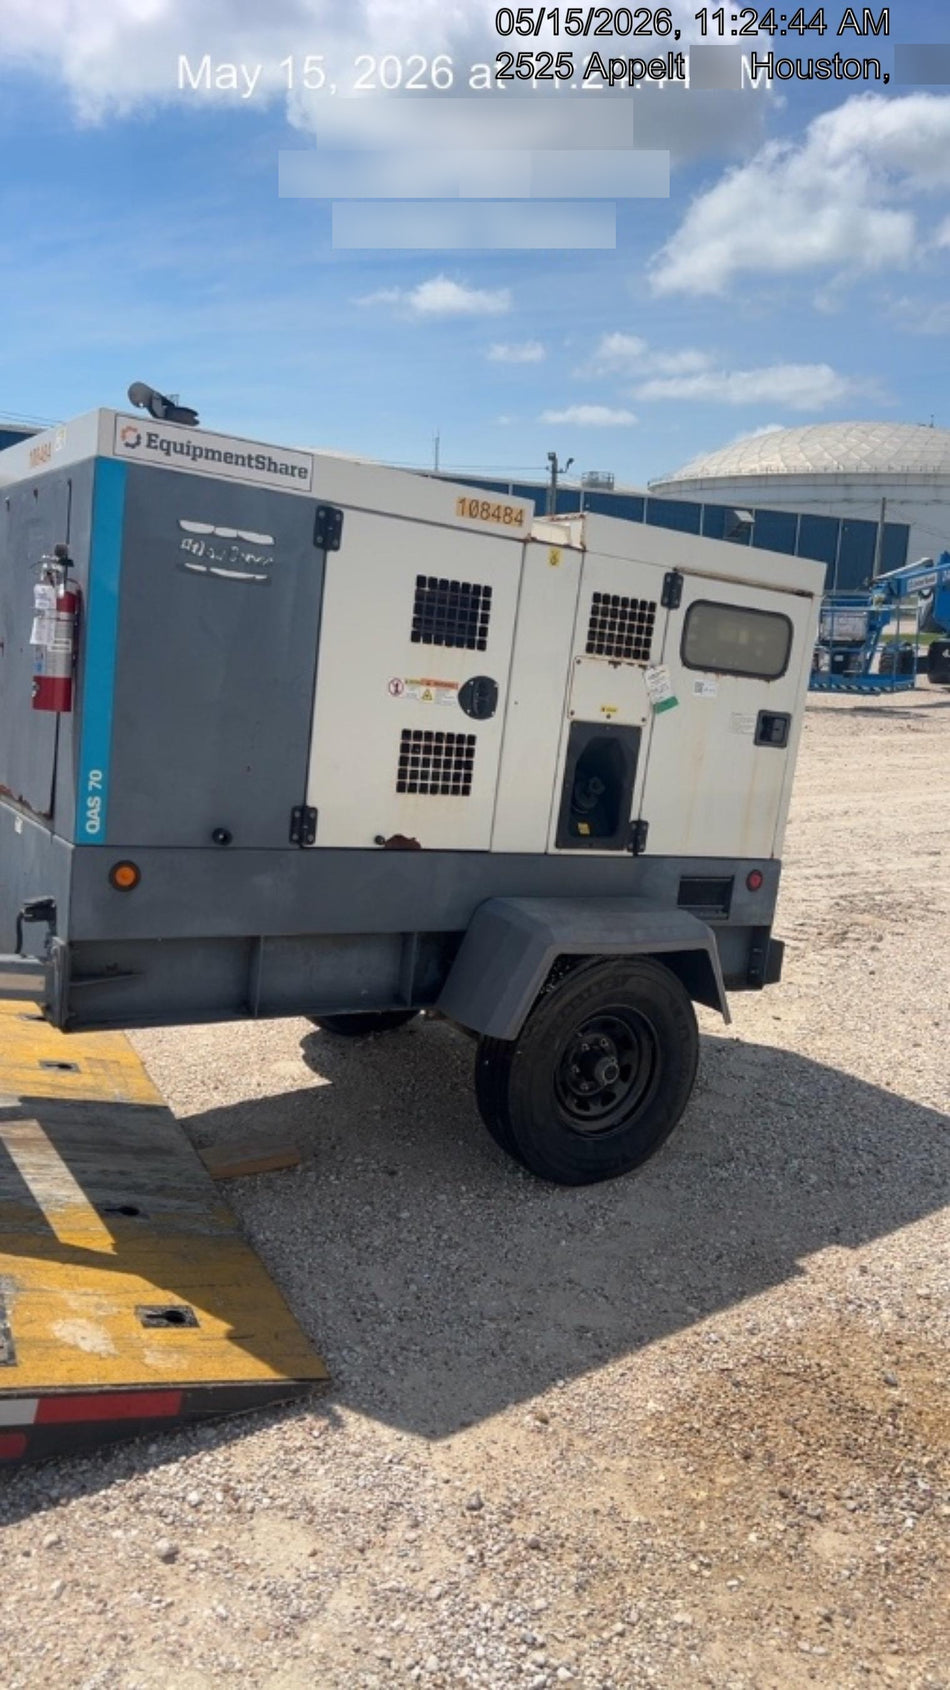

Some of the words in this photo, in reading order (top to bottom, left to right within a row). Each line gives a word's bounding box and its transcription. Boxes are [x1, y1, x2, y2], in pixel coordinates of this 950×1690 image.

[146, 432, 308, 480] EquipmentShare
[457, 496, 525, 527] 108484
[88, 769, 103, 791] 70
[86, 797, 101, 835] QAS
